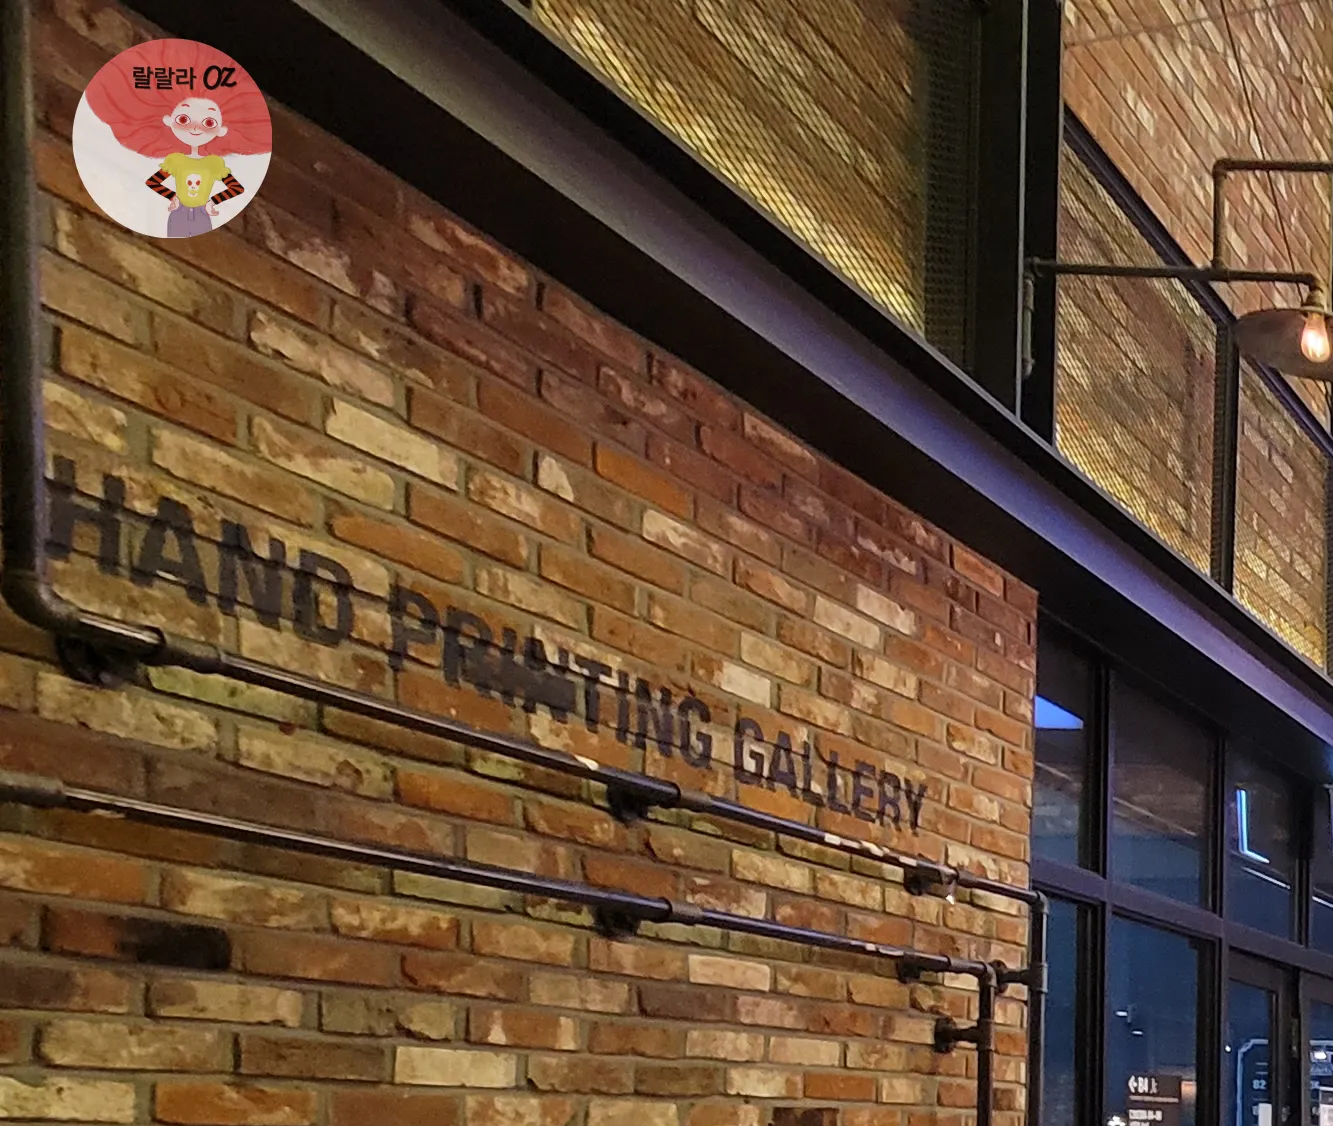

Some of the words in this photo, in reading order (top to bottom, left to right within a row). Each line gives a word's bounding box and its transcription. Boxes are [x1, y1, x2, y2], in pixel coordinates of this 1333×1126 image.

[48, 456, 354, 650] HAND
[387, 585, 713, 772] PRINTING
[733, 716, 928, 835] GALLERY
